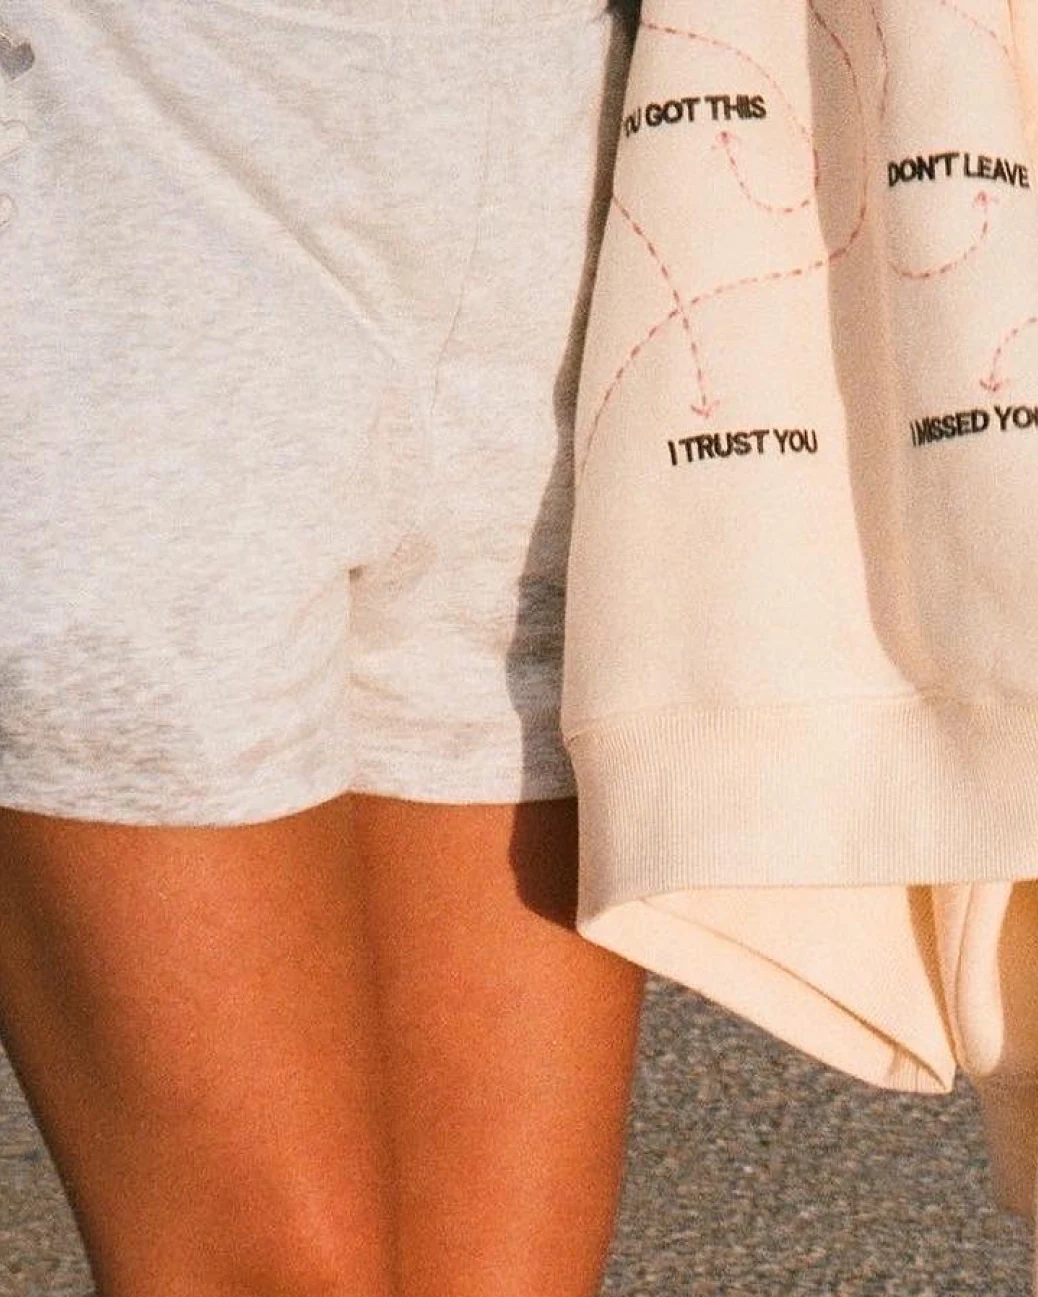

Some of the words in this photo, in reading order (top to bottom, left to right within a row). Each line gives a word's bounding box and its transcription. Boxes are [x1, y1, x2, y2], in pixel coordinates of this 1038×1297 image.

[644, 96, 701, 128] GOT
[703, 94, 767, 121] THIS
[887, 152, 960, 187] DON'T
[962, 152, 1031, 188] LEAVE
[909, 420, 917, 448] I
[916, 408, 990, 446] MISSED
[667, 439, 678, 466] I
[678, 429, 770, 462] TRUST
[772, 428, 819, 455] YOU
